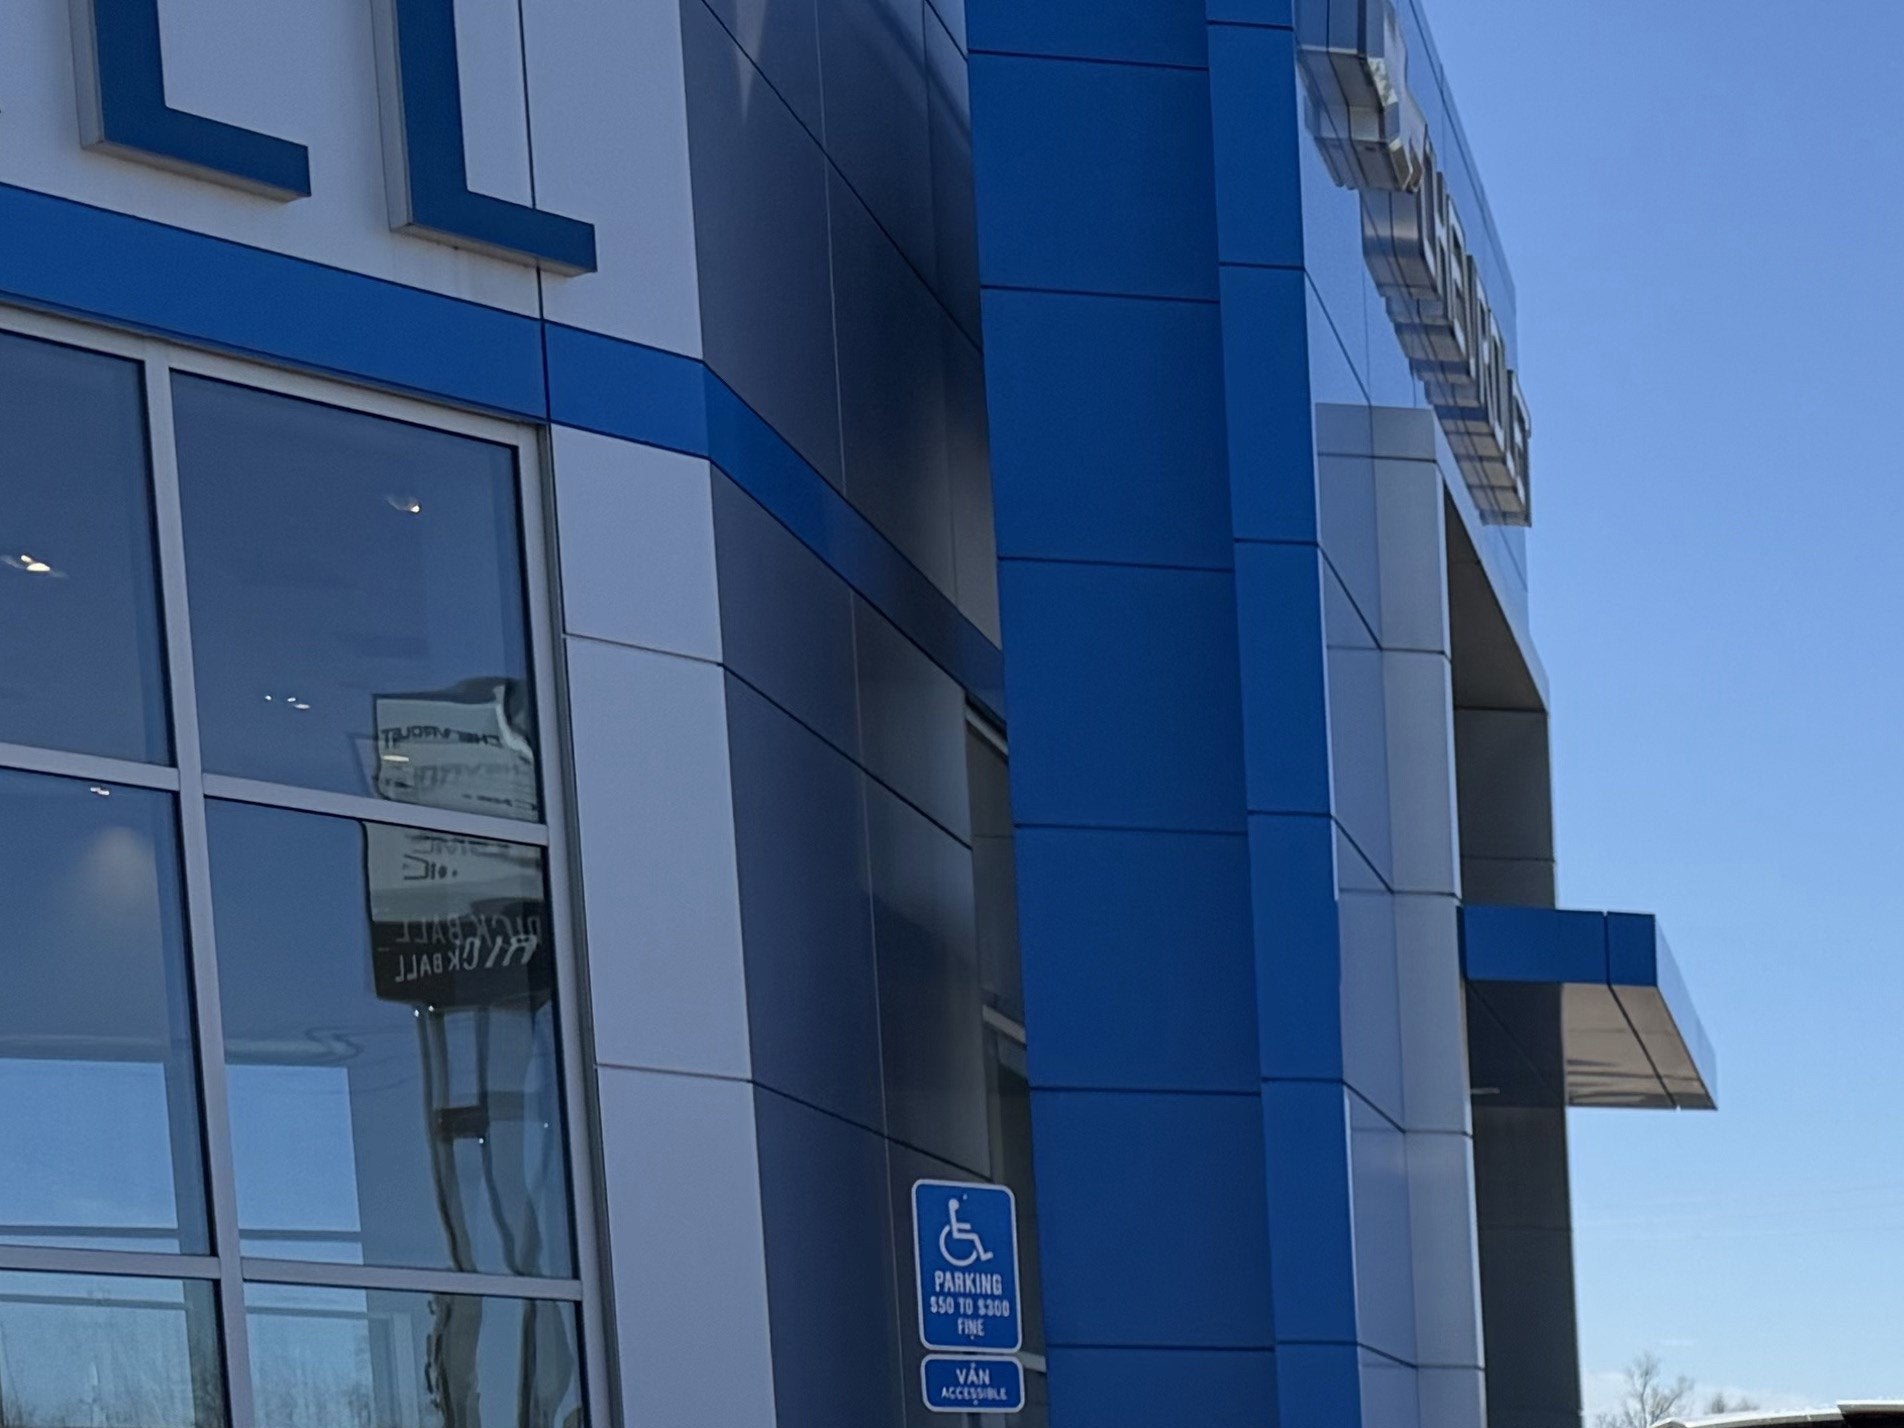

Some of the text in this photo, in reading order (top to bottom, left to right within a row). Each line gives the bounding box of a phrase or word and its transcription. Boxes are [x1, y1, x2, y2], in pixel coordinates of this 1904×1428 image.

[934, 1270, 1003, 1296] PARKING
[930, 1296, 1010, 1318] $50 TO $300
[957, 1318, 985, 1337] FINE
[956, 1367, 990, 1386] VAN
[940, 1387, 1008, 1401] ACCESSIBLE
